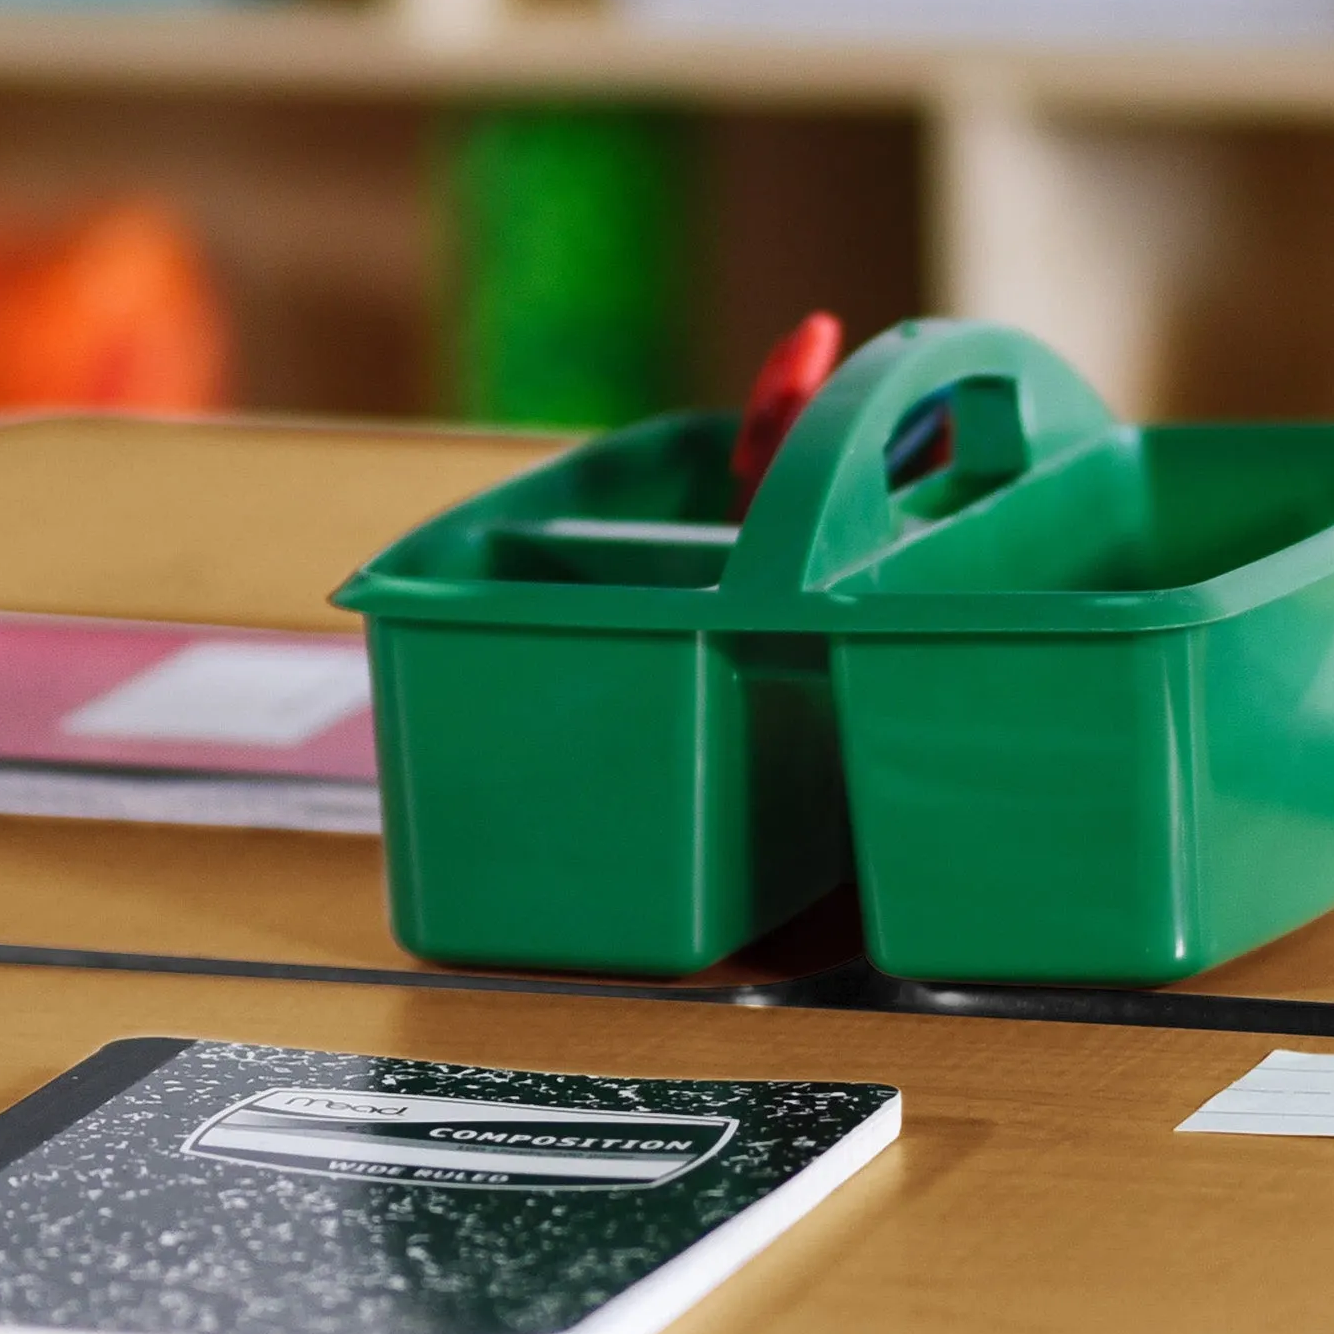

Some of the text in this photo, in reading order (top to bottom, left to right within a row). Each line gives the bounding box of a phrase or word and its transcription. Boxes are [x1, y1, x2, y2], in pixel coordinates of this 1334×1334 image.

[429, 1127, 693, 1151] COMPOSITION
[329, 1160, 509, 1184] WIDE RULED
